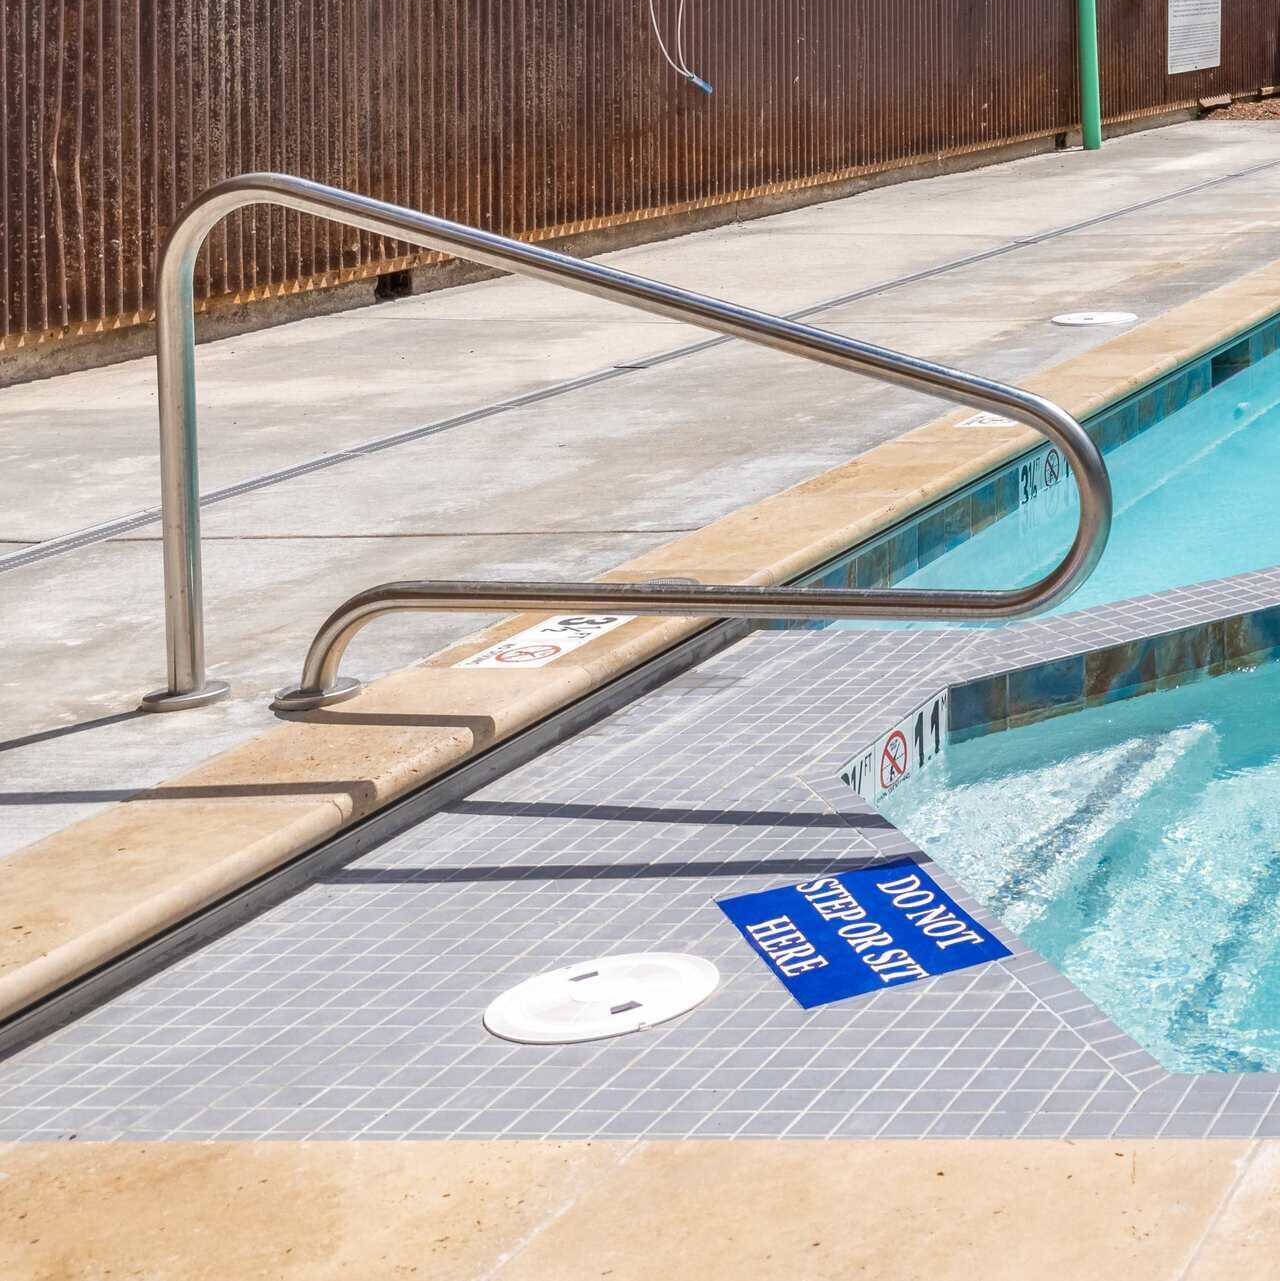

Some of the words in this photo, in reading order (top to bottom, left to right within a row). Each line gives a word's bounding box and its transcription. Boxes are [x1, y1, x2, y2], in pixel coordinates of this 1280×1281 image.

[795, 877, 867, 922] STEP
[876, 873, 935, 909] DO
[745, 914, 830, 978] HERE
[837, 920, 894, 955] OR
[905, 903, 985, 951] NOT
[862, 947, 931, 984] SIT
